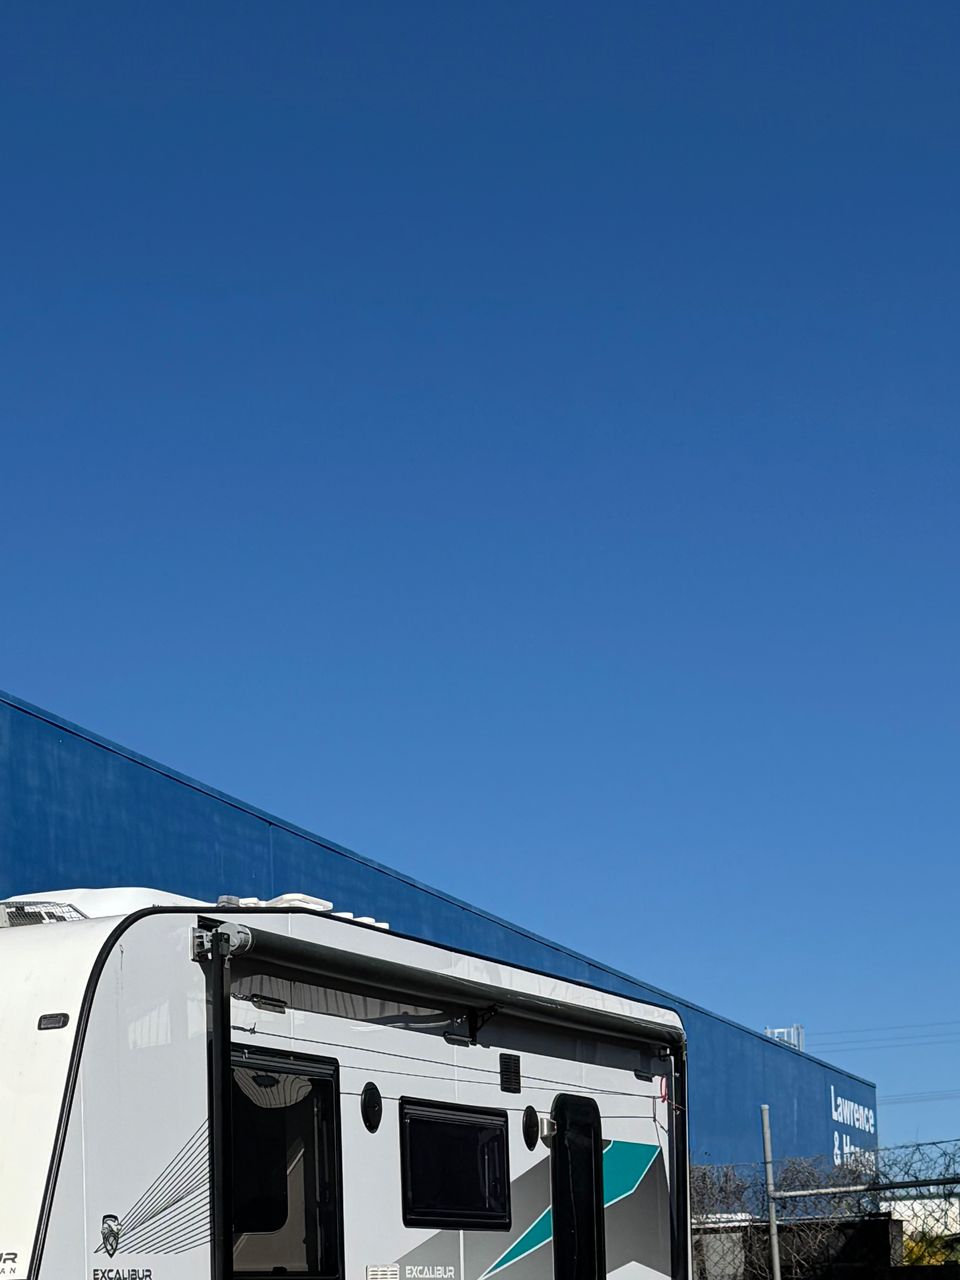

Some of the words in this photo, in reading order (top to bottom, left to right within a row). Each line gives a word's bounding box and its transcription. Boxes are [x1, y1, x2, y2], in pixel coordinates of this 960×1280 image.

[831, 1085, 875, 1134] Lawrence
[833, 1131, 842, 1166] &
[93, 1269, 152, 1280] EXCALIBUR
[405, 1266, 455, 1279] EXCALIBUR
